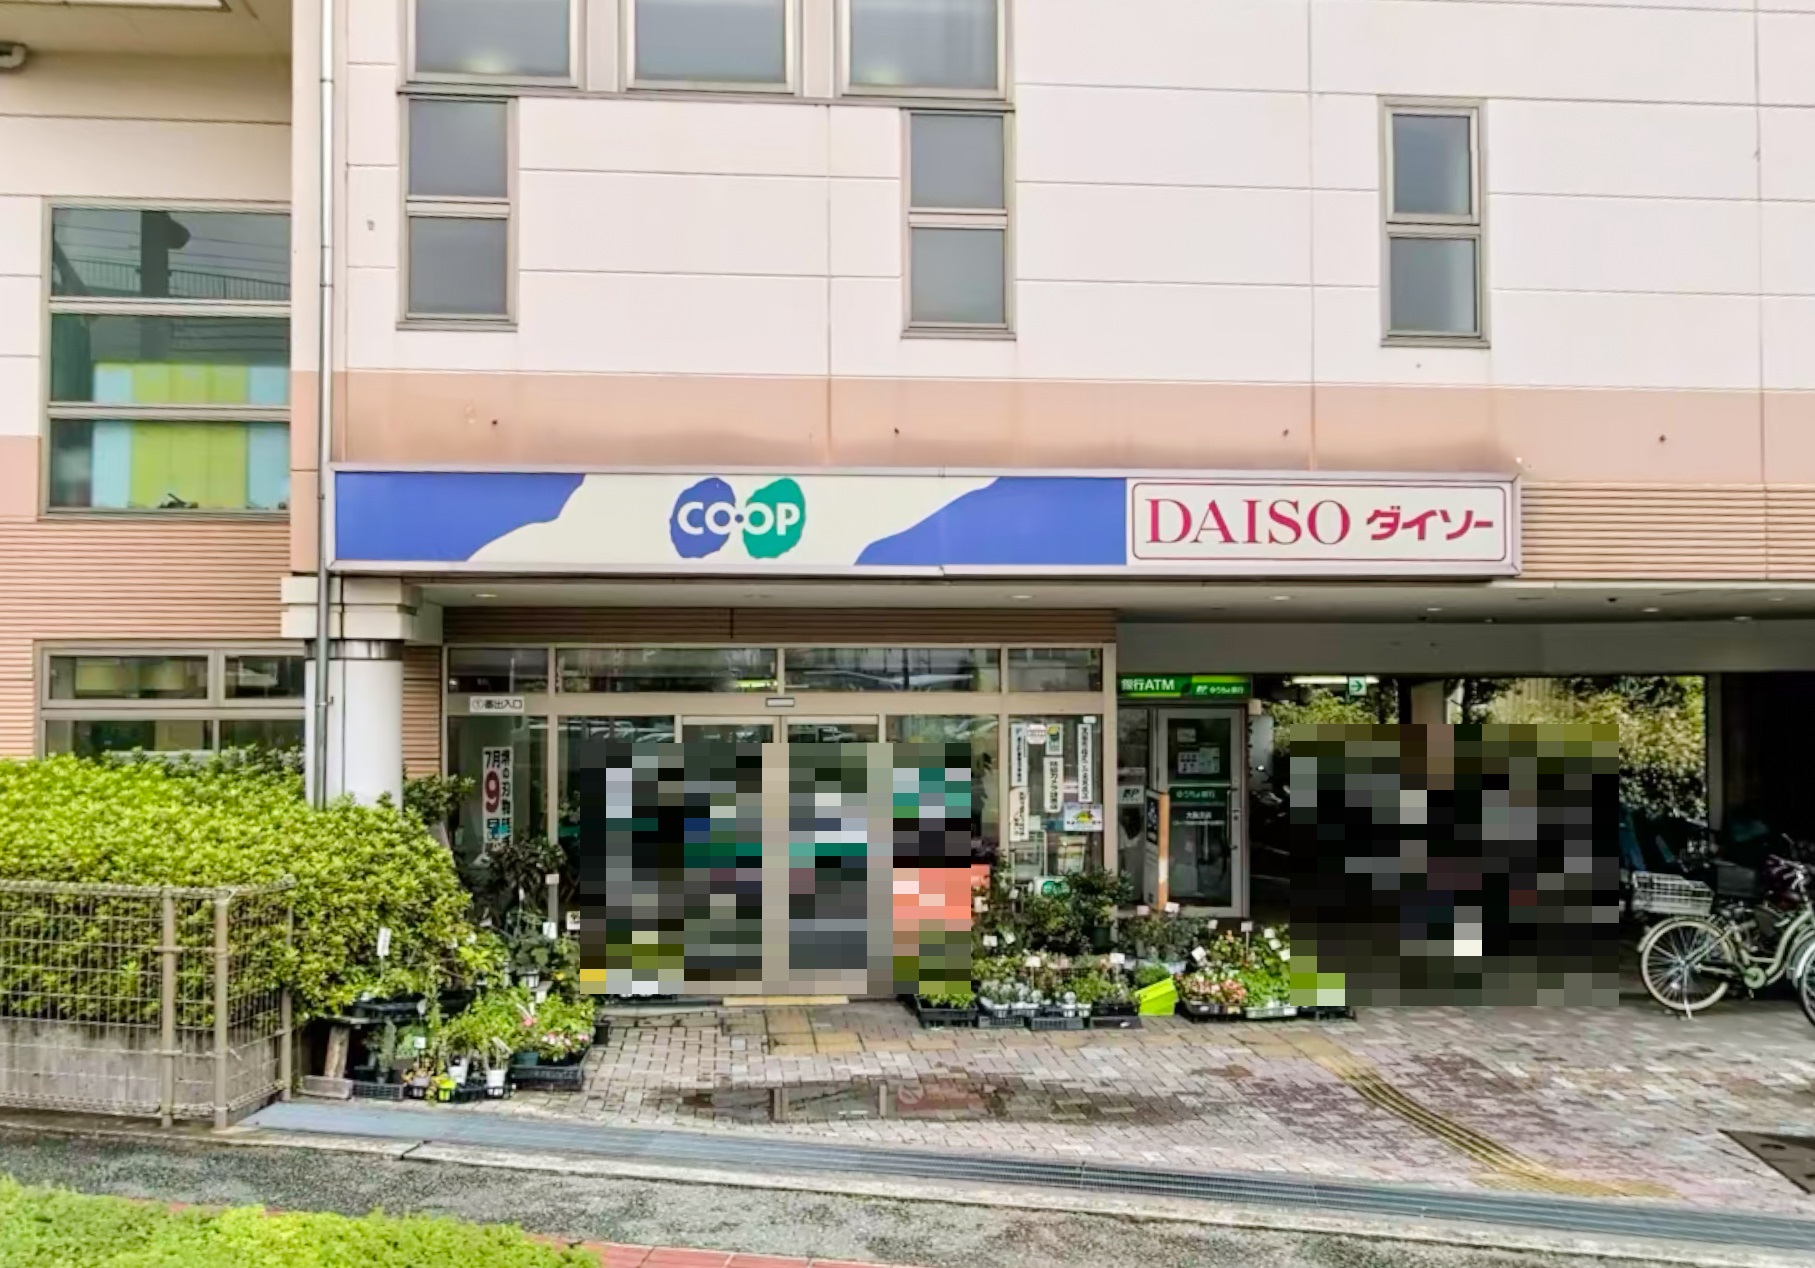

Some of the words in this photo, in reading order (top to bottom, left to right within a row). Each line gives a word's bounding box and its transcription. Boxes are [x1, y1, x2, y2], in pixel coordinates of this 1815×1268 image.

[1145, 498, 1351, 545] DAISO
[1366, 505, 1494, 541] ダイソー
[1121, 678, 1175, 692] 銀行ATM
